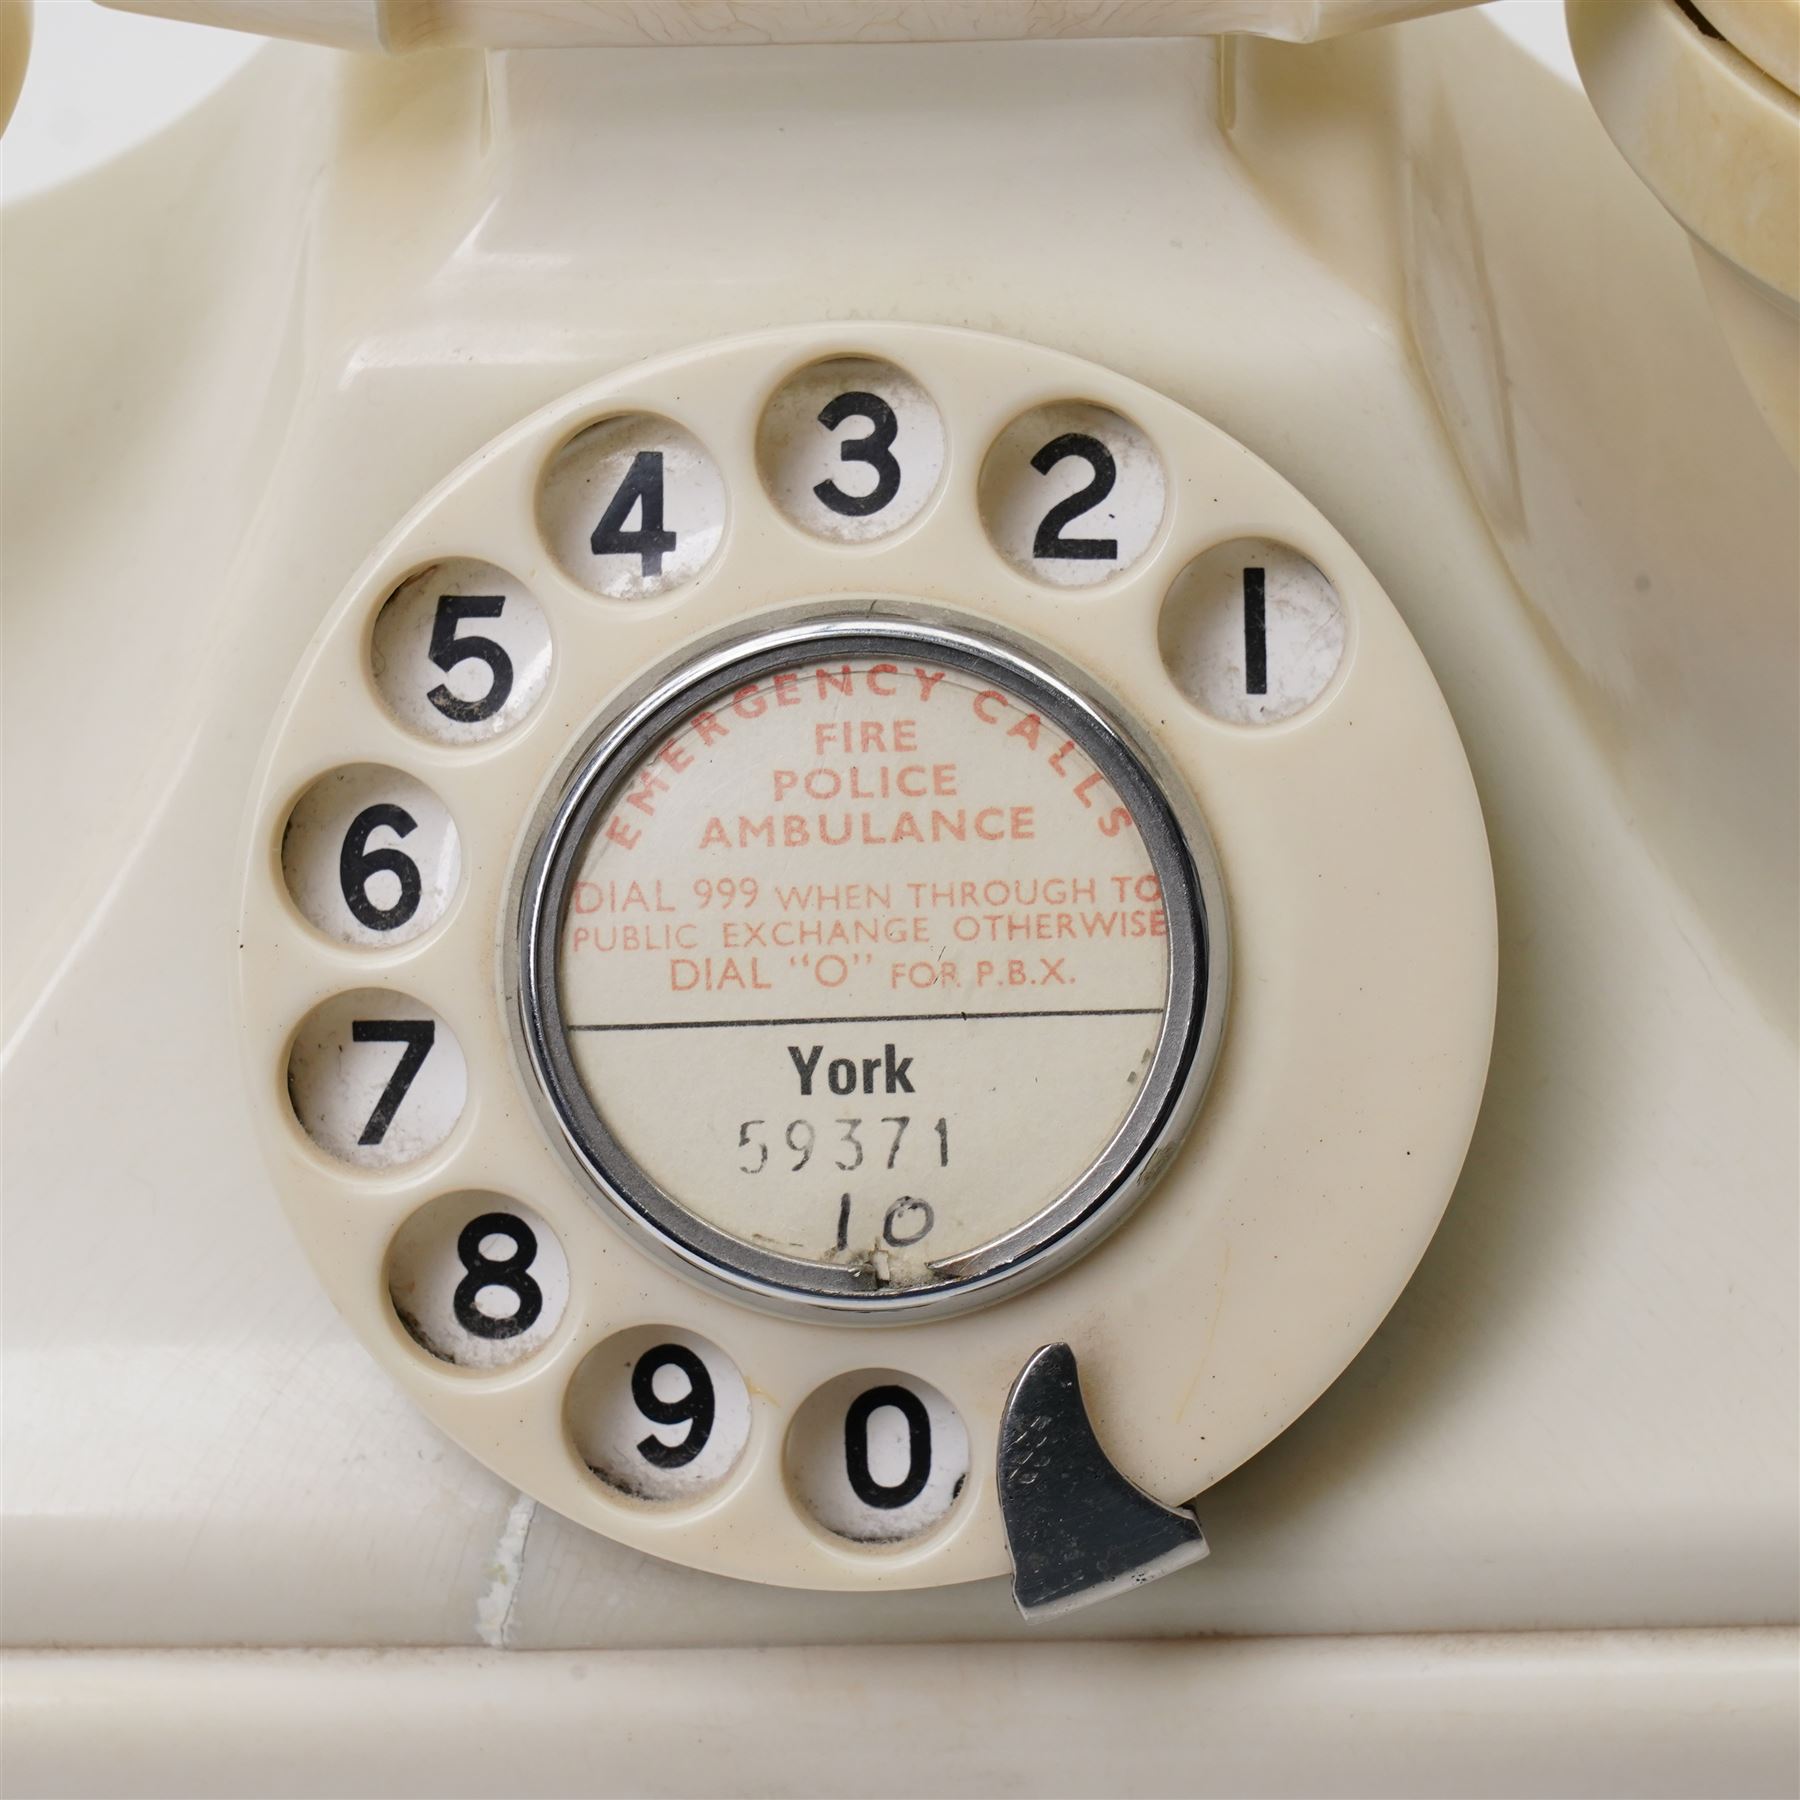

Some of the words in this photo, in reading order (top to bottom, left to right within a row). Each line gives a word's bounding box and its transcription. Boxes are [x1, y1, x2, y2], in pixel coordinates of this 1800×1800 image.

[590, 451, 676, 576] 4
[813, 391, 901, 516] 3
[1030, 432, 1118, 560] 2
[428, 594, 513, 719] 5
[1242, 566, 1267, 695] 1
[604, 663, 946, 850] EMERGENCY
[972, 689, 1133, 838] CALLS
[773, 762, 957, 801] POLICE
[815, 719, 918, 755] FIRE
[339, 803, 422, 931] 6
[699, 805, 1035, 849] AMBULANCE
[572, 879, 676, 915] DIAL
[692, 877, 760, 910] 999
[774, 884, 891, 913] WHEN
[906, 878, 1097, 908] THROUGH
[1111, 873, 1162, 904] TO
[572, 923, 699, 952] PUBLIC
[722, 916, 931, 948] EXCHANGE
[952, 909, 1168, 942] OTHERWISE
[670, 957, 772, 991] DIAL
[890, 960, 961, 989] FOR
[975, 957, 1076, 987] P.B.X.
[351, 1019, 435, 1145] 7
[787, 1043, 916, 1096] York
[738, 1115, 949, 1174] 59371
[453, 1212, 543, 1340] 8
[630, 1342, 715, 1468] 9
[844, 1384, 932, 1510] 0
